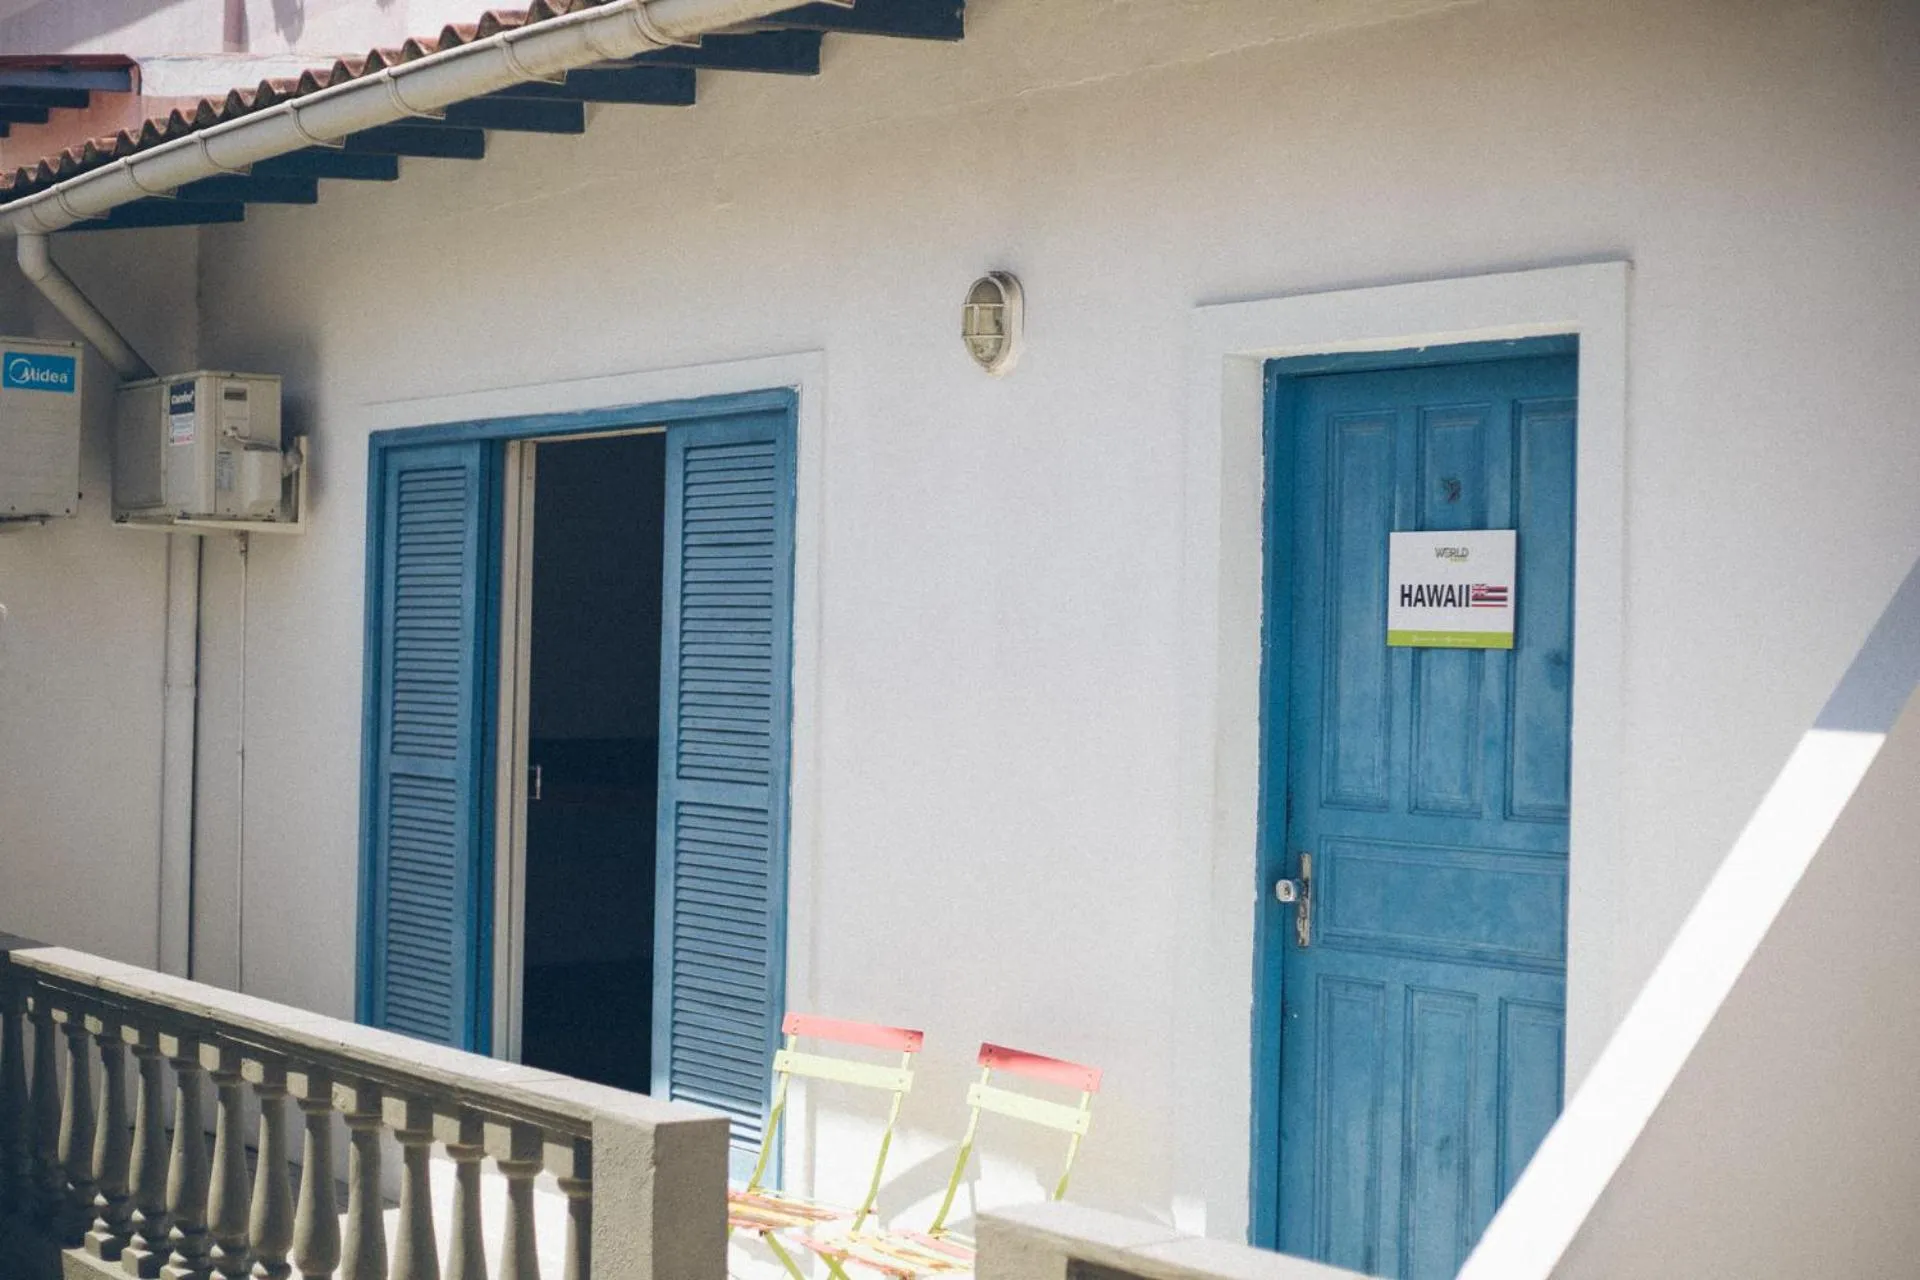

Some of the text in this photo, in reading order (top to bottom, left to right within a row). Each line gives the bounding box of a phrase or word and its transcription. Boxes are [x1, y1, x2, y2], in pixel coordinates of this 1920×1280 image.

[10, 358, 68, 384] Midea
[1434, 547, 1470, 558] WORLD
[1400, 584, 1470, 608] HAWAII
